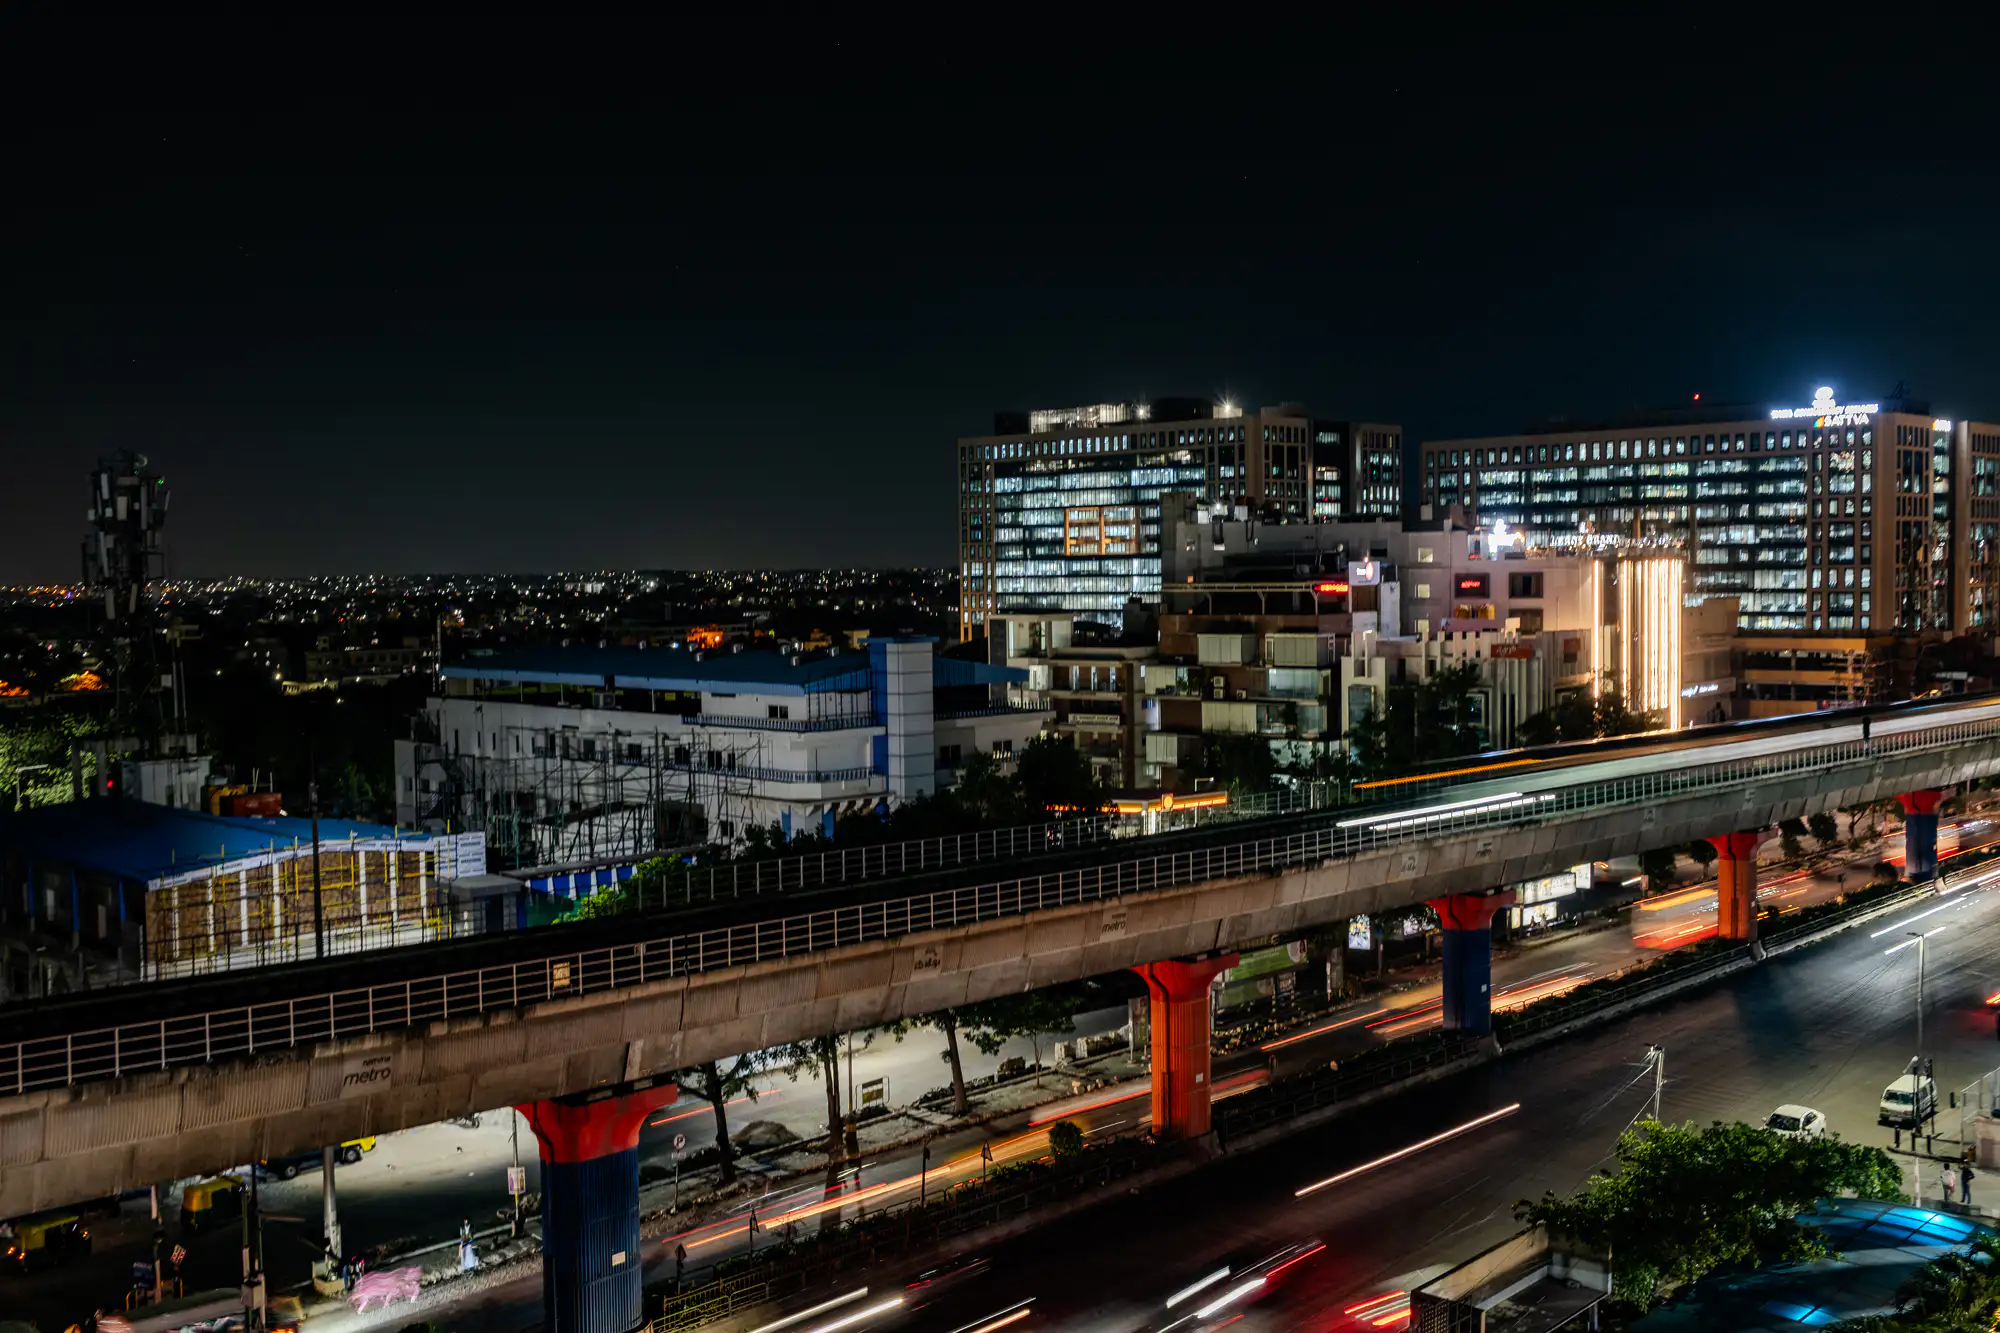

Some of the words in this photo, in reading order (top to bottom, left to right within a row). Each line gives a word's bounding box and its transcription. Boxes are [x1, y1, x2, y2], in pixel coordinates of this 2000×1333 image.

[1823, 412, 1869, 427] SATTVA
[1101, 920, 1126, 933] metro
[342, 1066, 392, 1088] metro
